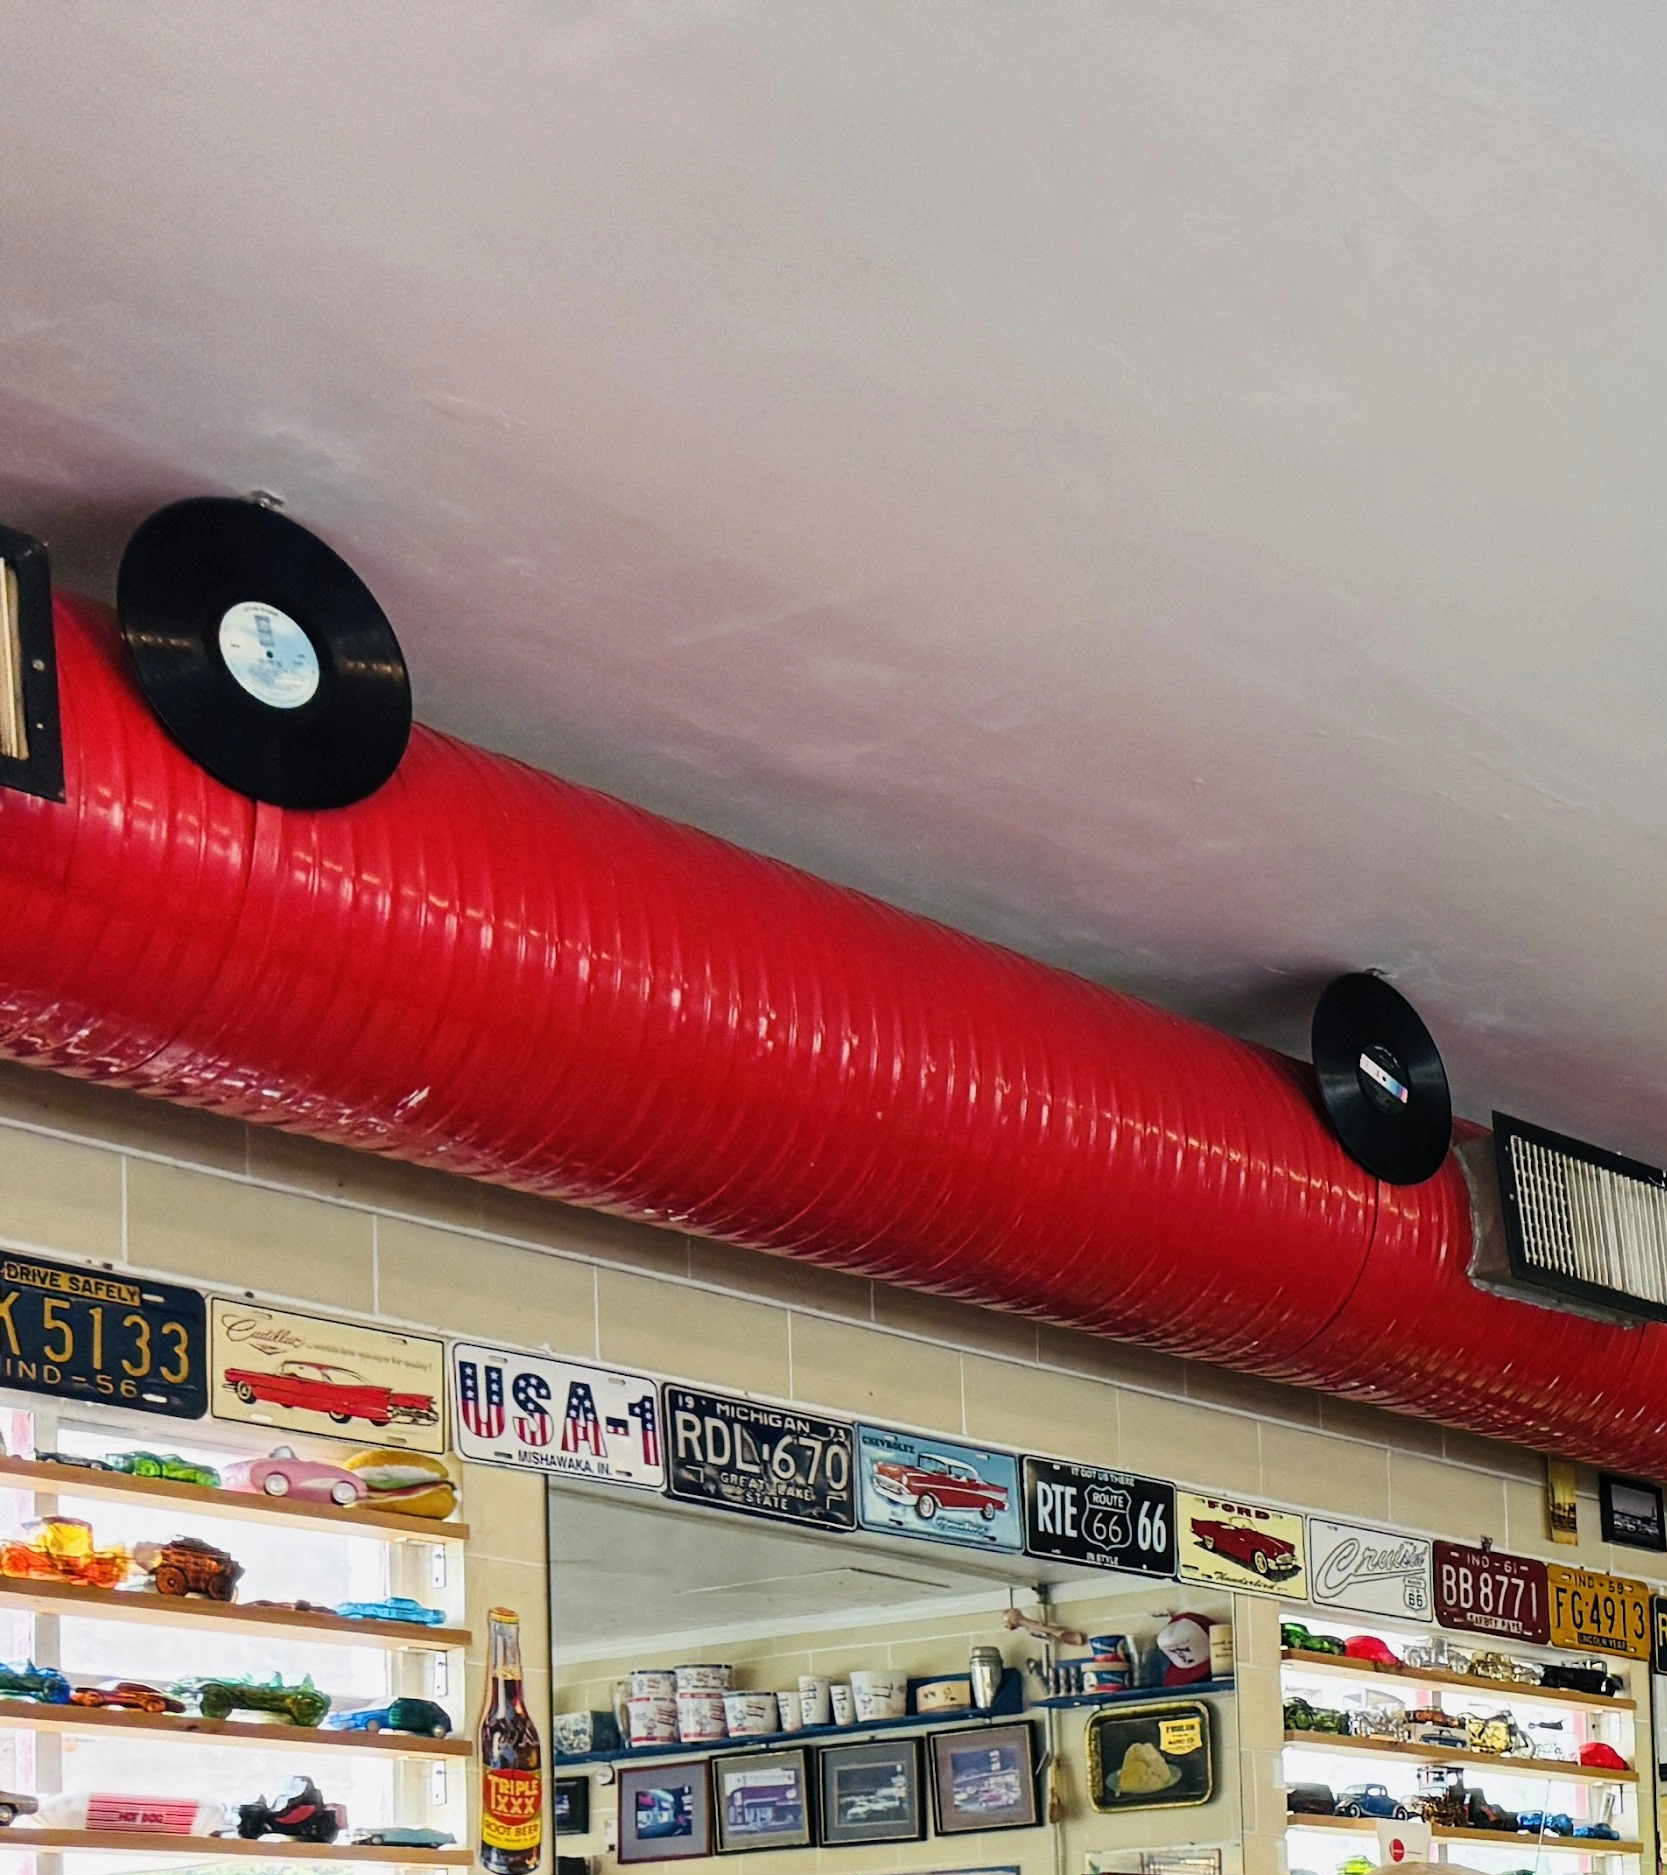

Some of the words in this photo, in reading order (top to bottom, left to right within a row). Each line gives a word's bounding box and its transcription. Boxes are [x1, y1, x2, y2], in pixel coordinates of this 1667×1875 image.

[6, 1263, 61, 1288] DRIVE
[69, 1276, 138, 1302] SAFELY
[458, 1360, 660, 1467] USA-1
[677, 1394, 695, 1410] 19
[715, 1401, 811, 1435] MICHIGAN
[518, 1450, 592, 1472] MISHAWAKA
[720, 1471, 766, 1493] GREAT
[745, 1490, 789, 1511] STATE
[1035, 1480, 1079, 1538] RTE
[1091, 1490, 1125, 1508] ROUTE
[1207, 1499, 1271, 1521] FORD
[1092, 1511, 1123, 1544] 66
[1136, 1500, 1167, 1554] 66
[1407, 1593, 1424, 1608] 66
[487, 1774, 539, 1803] TRIPLE
[496, 1795, 536, 1815] XXX
